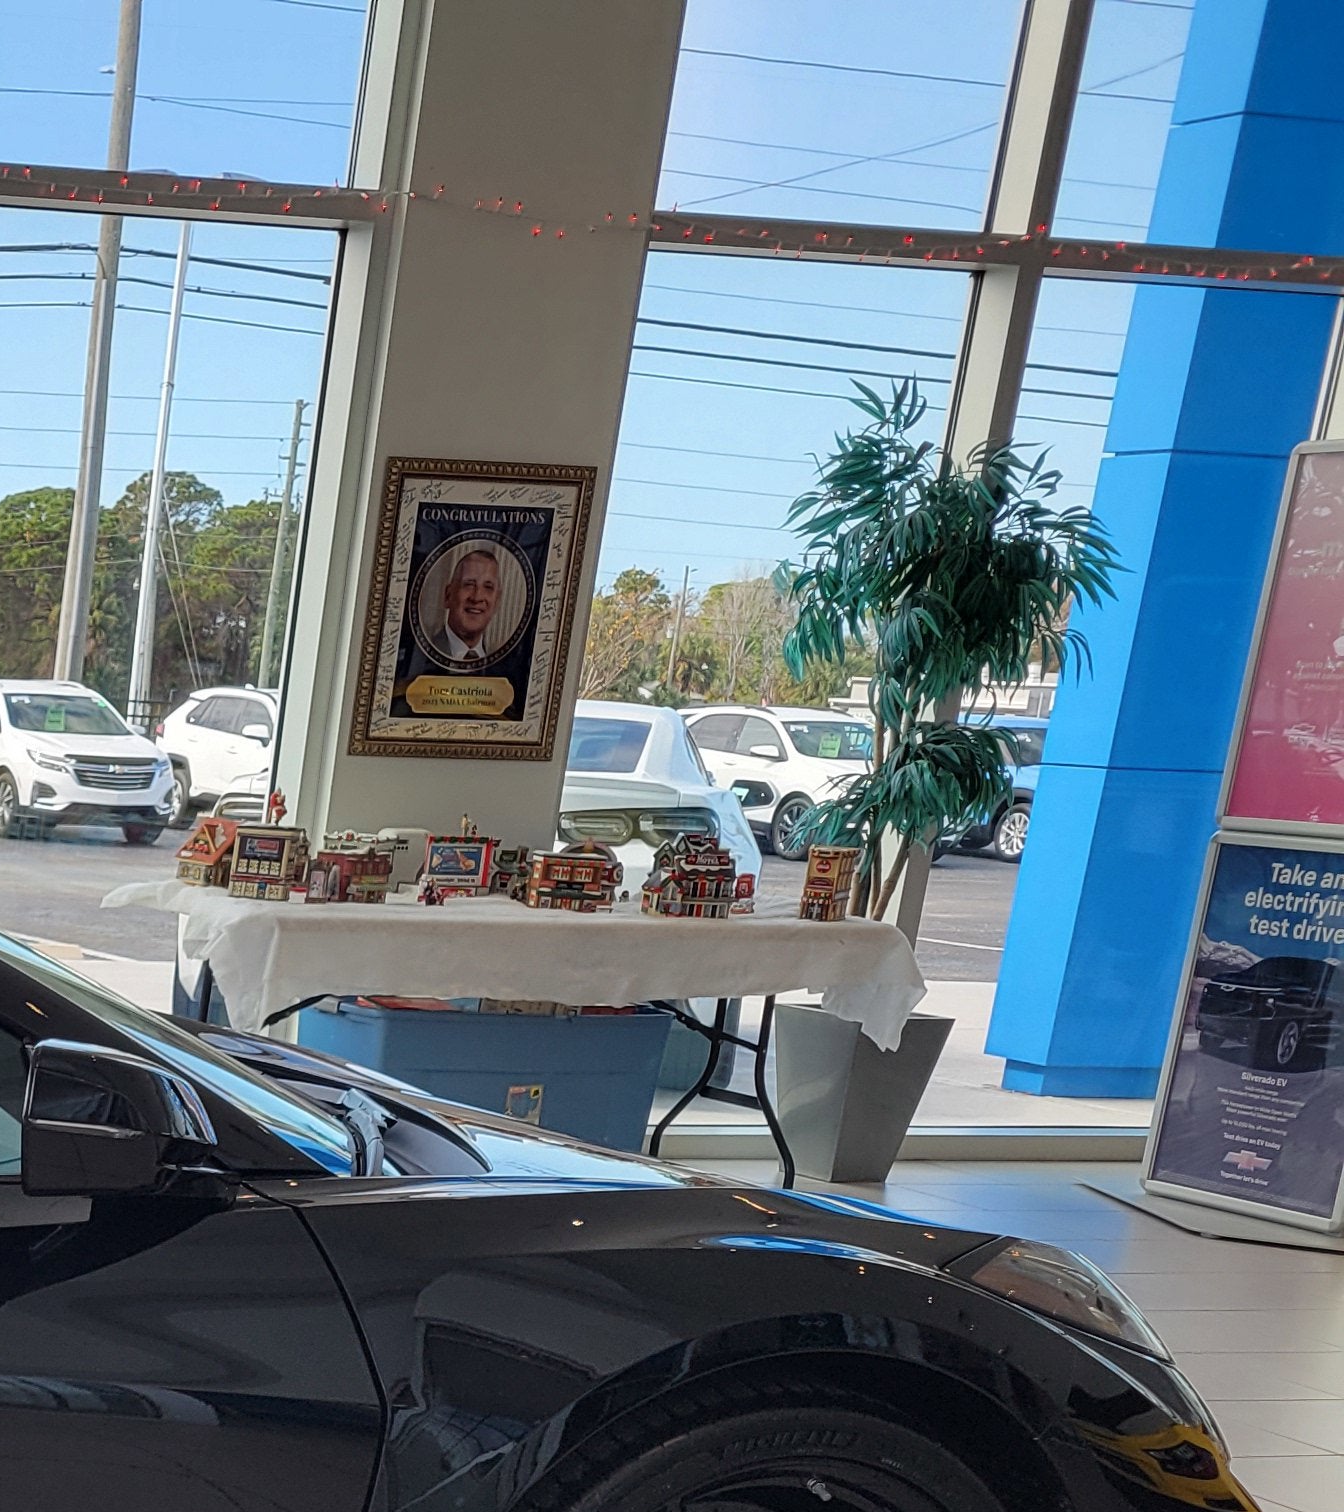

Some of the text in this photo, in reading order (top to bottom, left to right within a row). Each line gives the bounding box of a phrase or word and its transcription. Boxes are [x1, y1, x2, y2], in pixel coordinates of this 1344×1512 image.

[422, 508, 546, 524] CONGRATULATIONS
[1272, 863, 1317, 887] Take
[1250, 915, 1290, 938] test
[1241, 1072, 1288, 1087] Silverado EV
